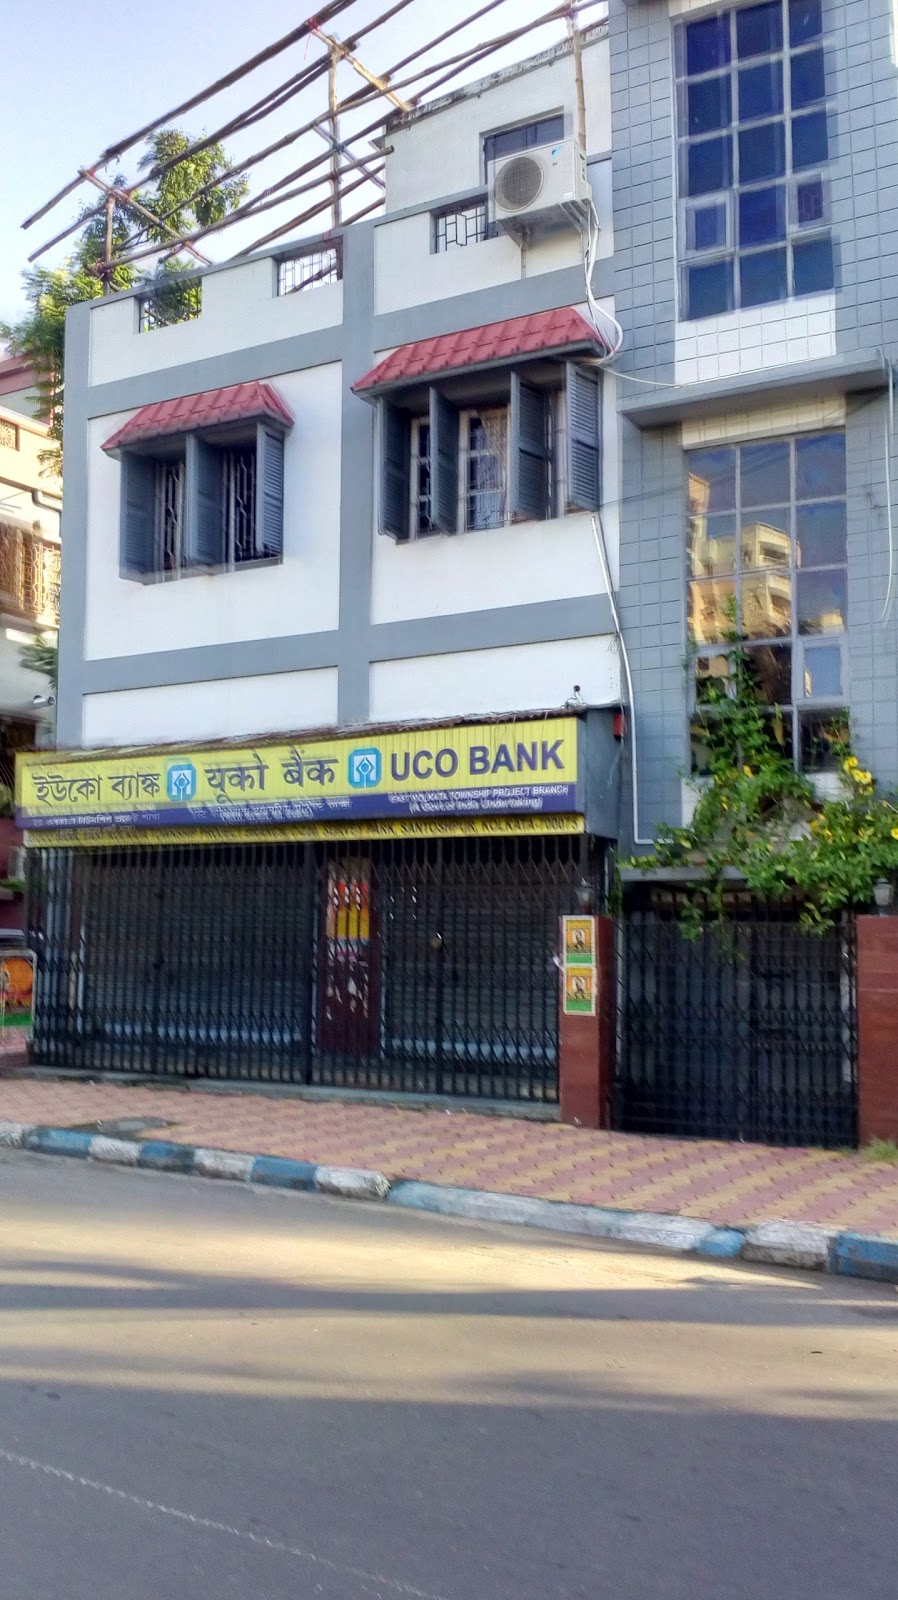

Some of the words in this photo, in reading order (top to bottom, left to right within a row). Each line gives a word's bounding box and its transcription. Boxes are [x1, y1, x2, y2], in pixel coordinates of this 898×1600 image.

[205, 750, 269, 804] यूको
[282, 746, 339, 789] बैंक
[391, 748, 459, 781] UCO
[469, 739, 565, 776] BANK
[32, 772, 103, 806] ইউকো
[108, 771, 161, 801] ব্যাঙ্ক
[450, 788, 491, 800] TOWNSHIP
[493, 786, 531, 798] PROJECT
[532, 784, 568, 796] BRANCH
